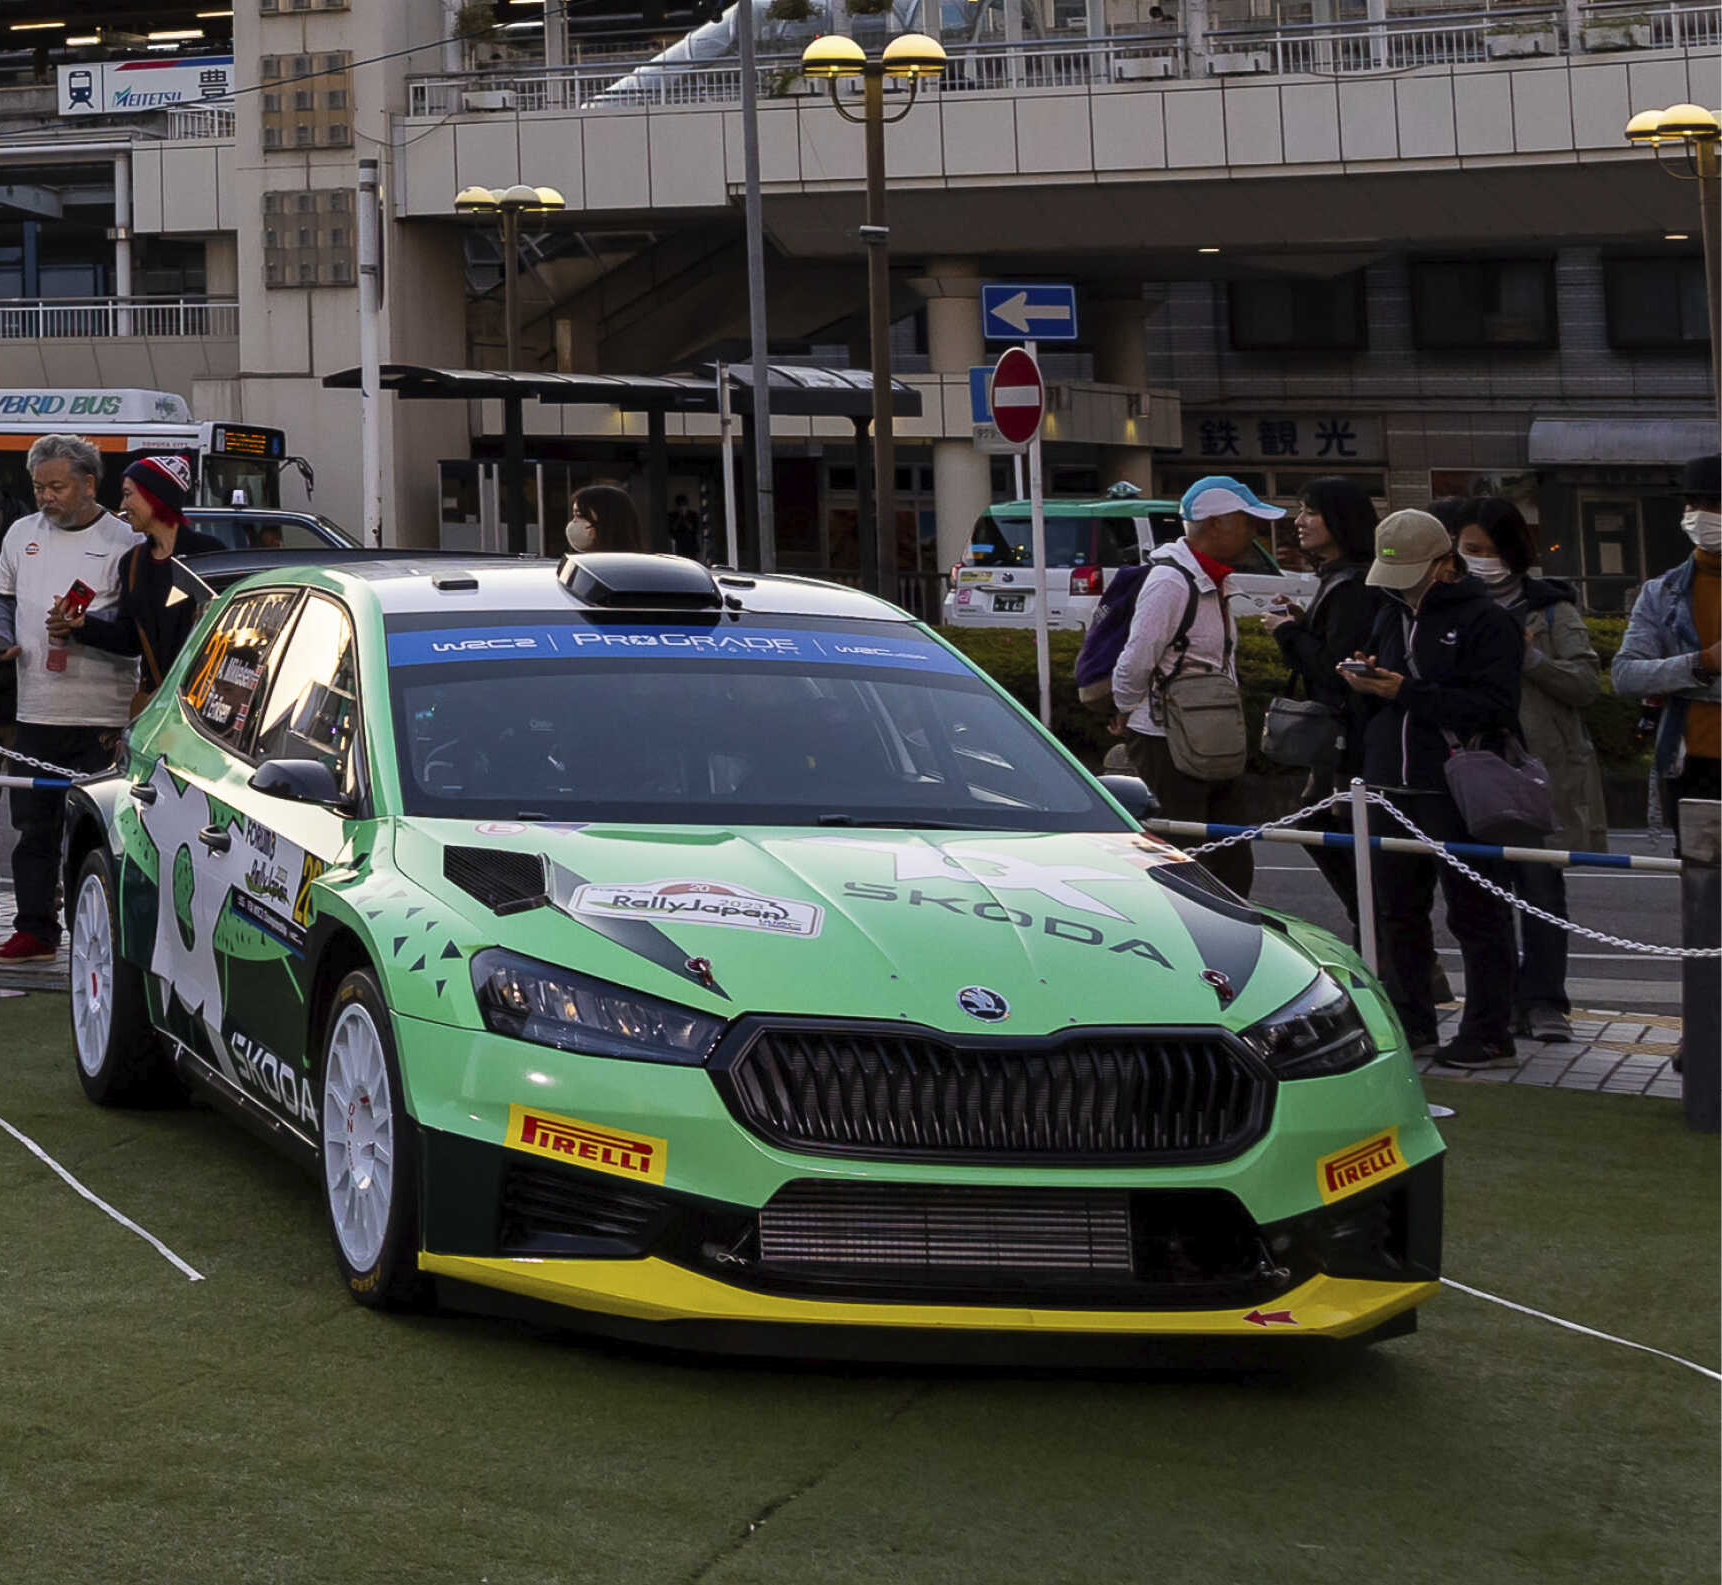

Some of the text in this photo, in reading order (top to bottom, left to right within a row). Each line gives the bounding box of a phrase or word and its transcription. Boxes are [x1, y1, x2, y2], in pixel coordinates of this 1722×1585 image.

[69, 395, 123, 415] BUS
[1158, 419, 1357, 457] 鉄観光
[612, 895, 786, 921] RallyJapan
[520, 1114, 654, 1173] PIRELLI
[1324, 1136, 1397, 1193] PIRELLI
